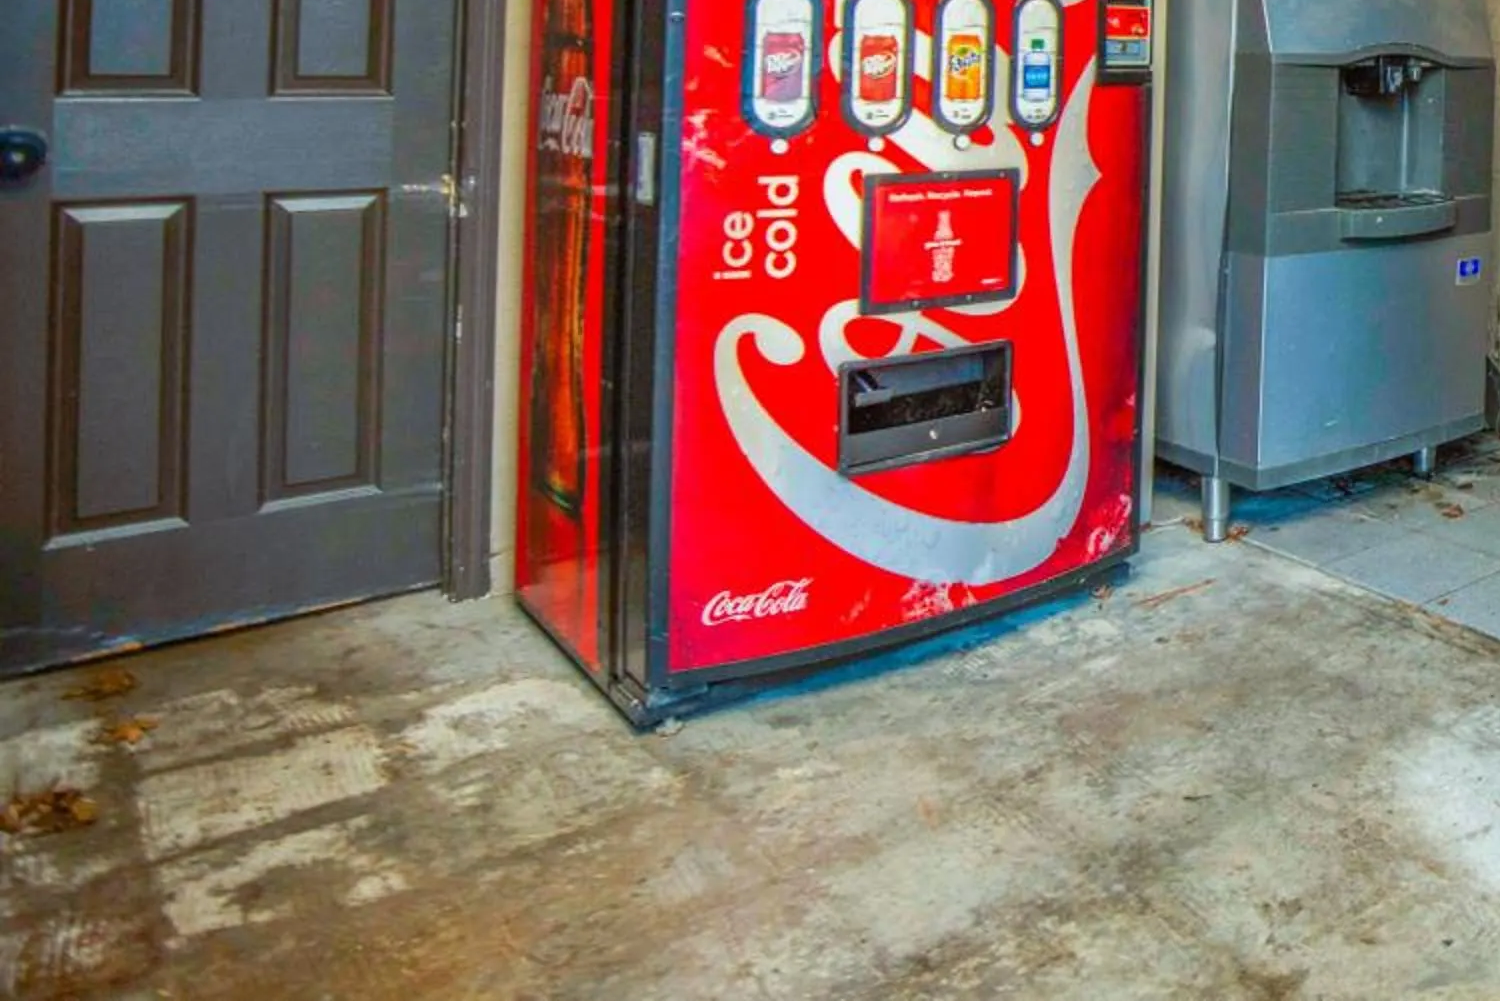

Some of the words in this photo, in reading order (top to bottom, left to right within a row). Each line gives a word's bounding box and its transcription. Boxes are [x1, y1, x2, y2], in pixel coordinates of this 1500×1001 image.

[712, 210, 755, 280] ice
[756, 174, 800, 279] cold
[701, 577, 814, 626] Coca-Cola
